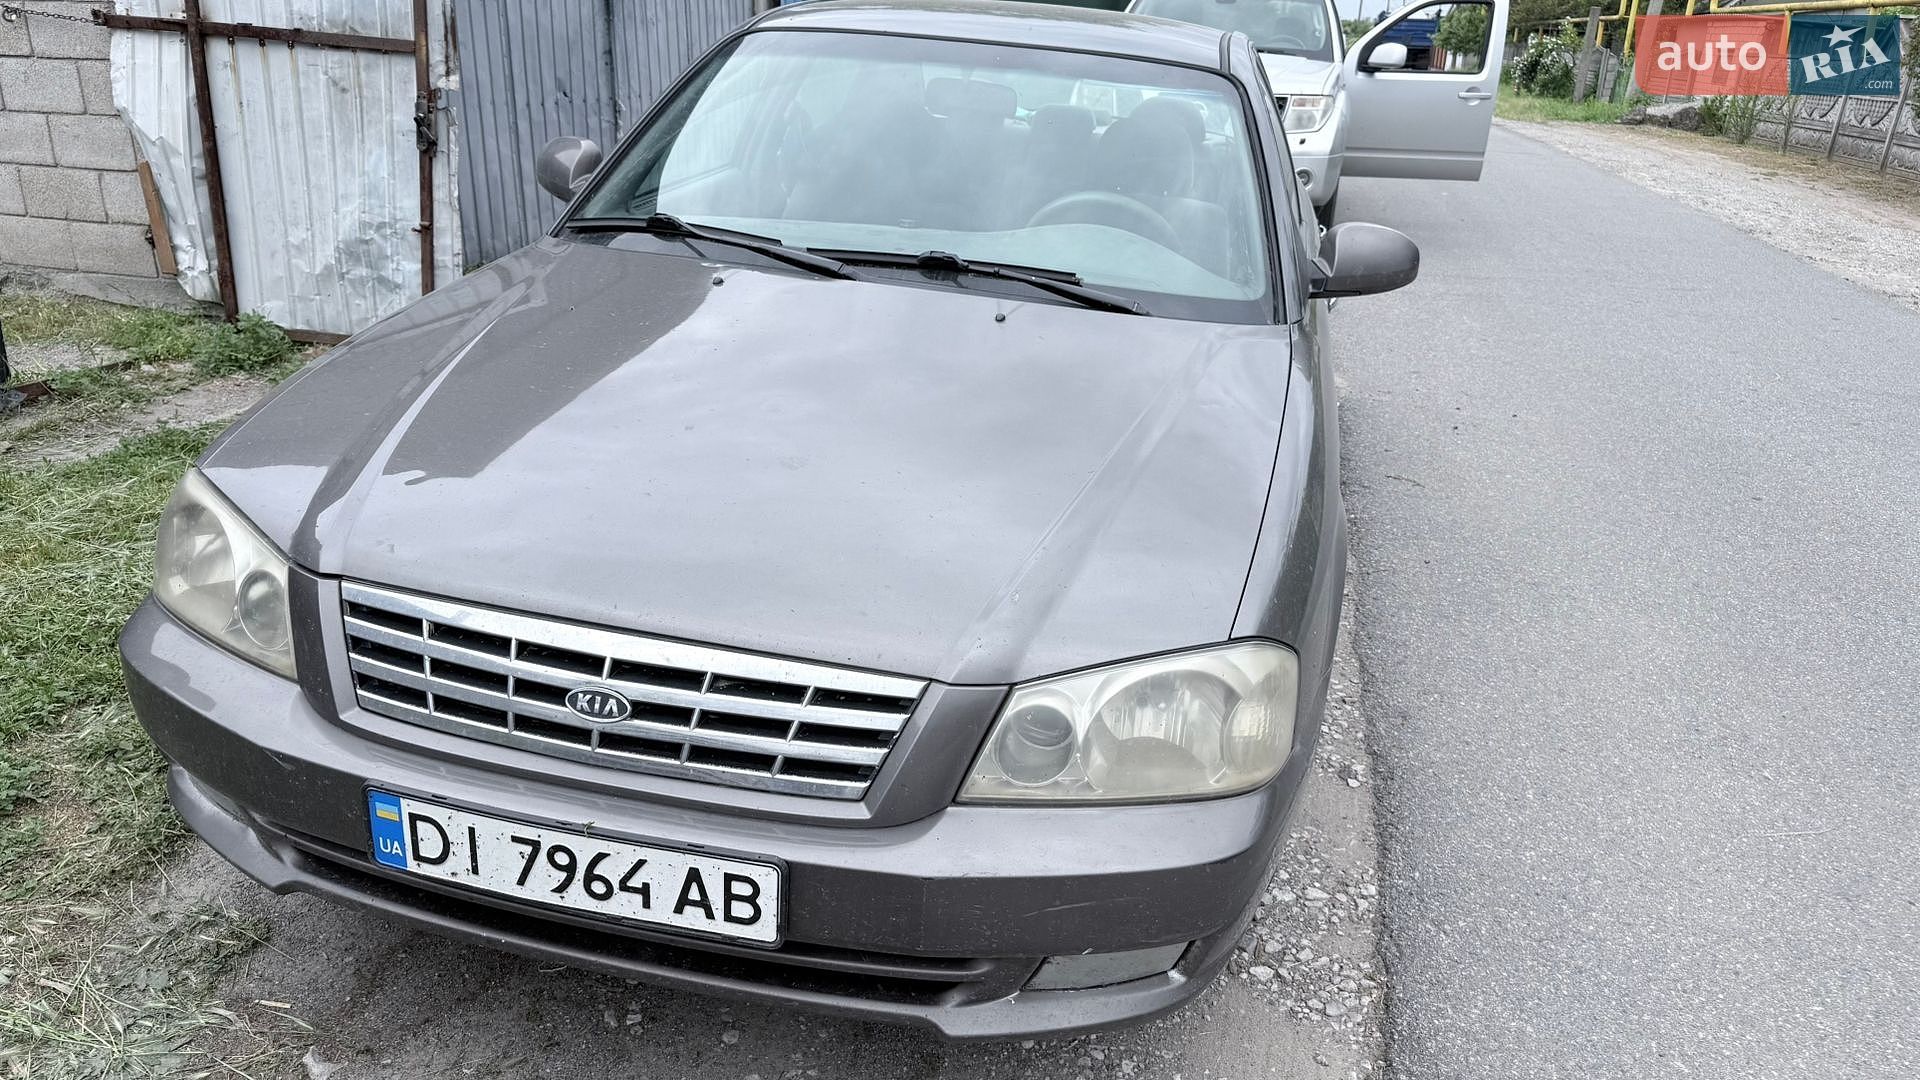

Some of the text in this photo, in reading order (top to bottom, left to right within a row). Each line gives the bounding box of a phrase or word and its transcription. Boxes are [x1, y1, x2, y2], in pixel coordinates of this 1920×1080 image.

[576, 692, 619, 717] KIA
[379, 836, 402, 857] UA
[408, 811, 762, 926] DI 7964 AB
